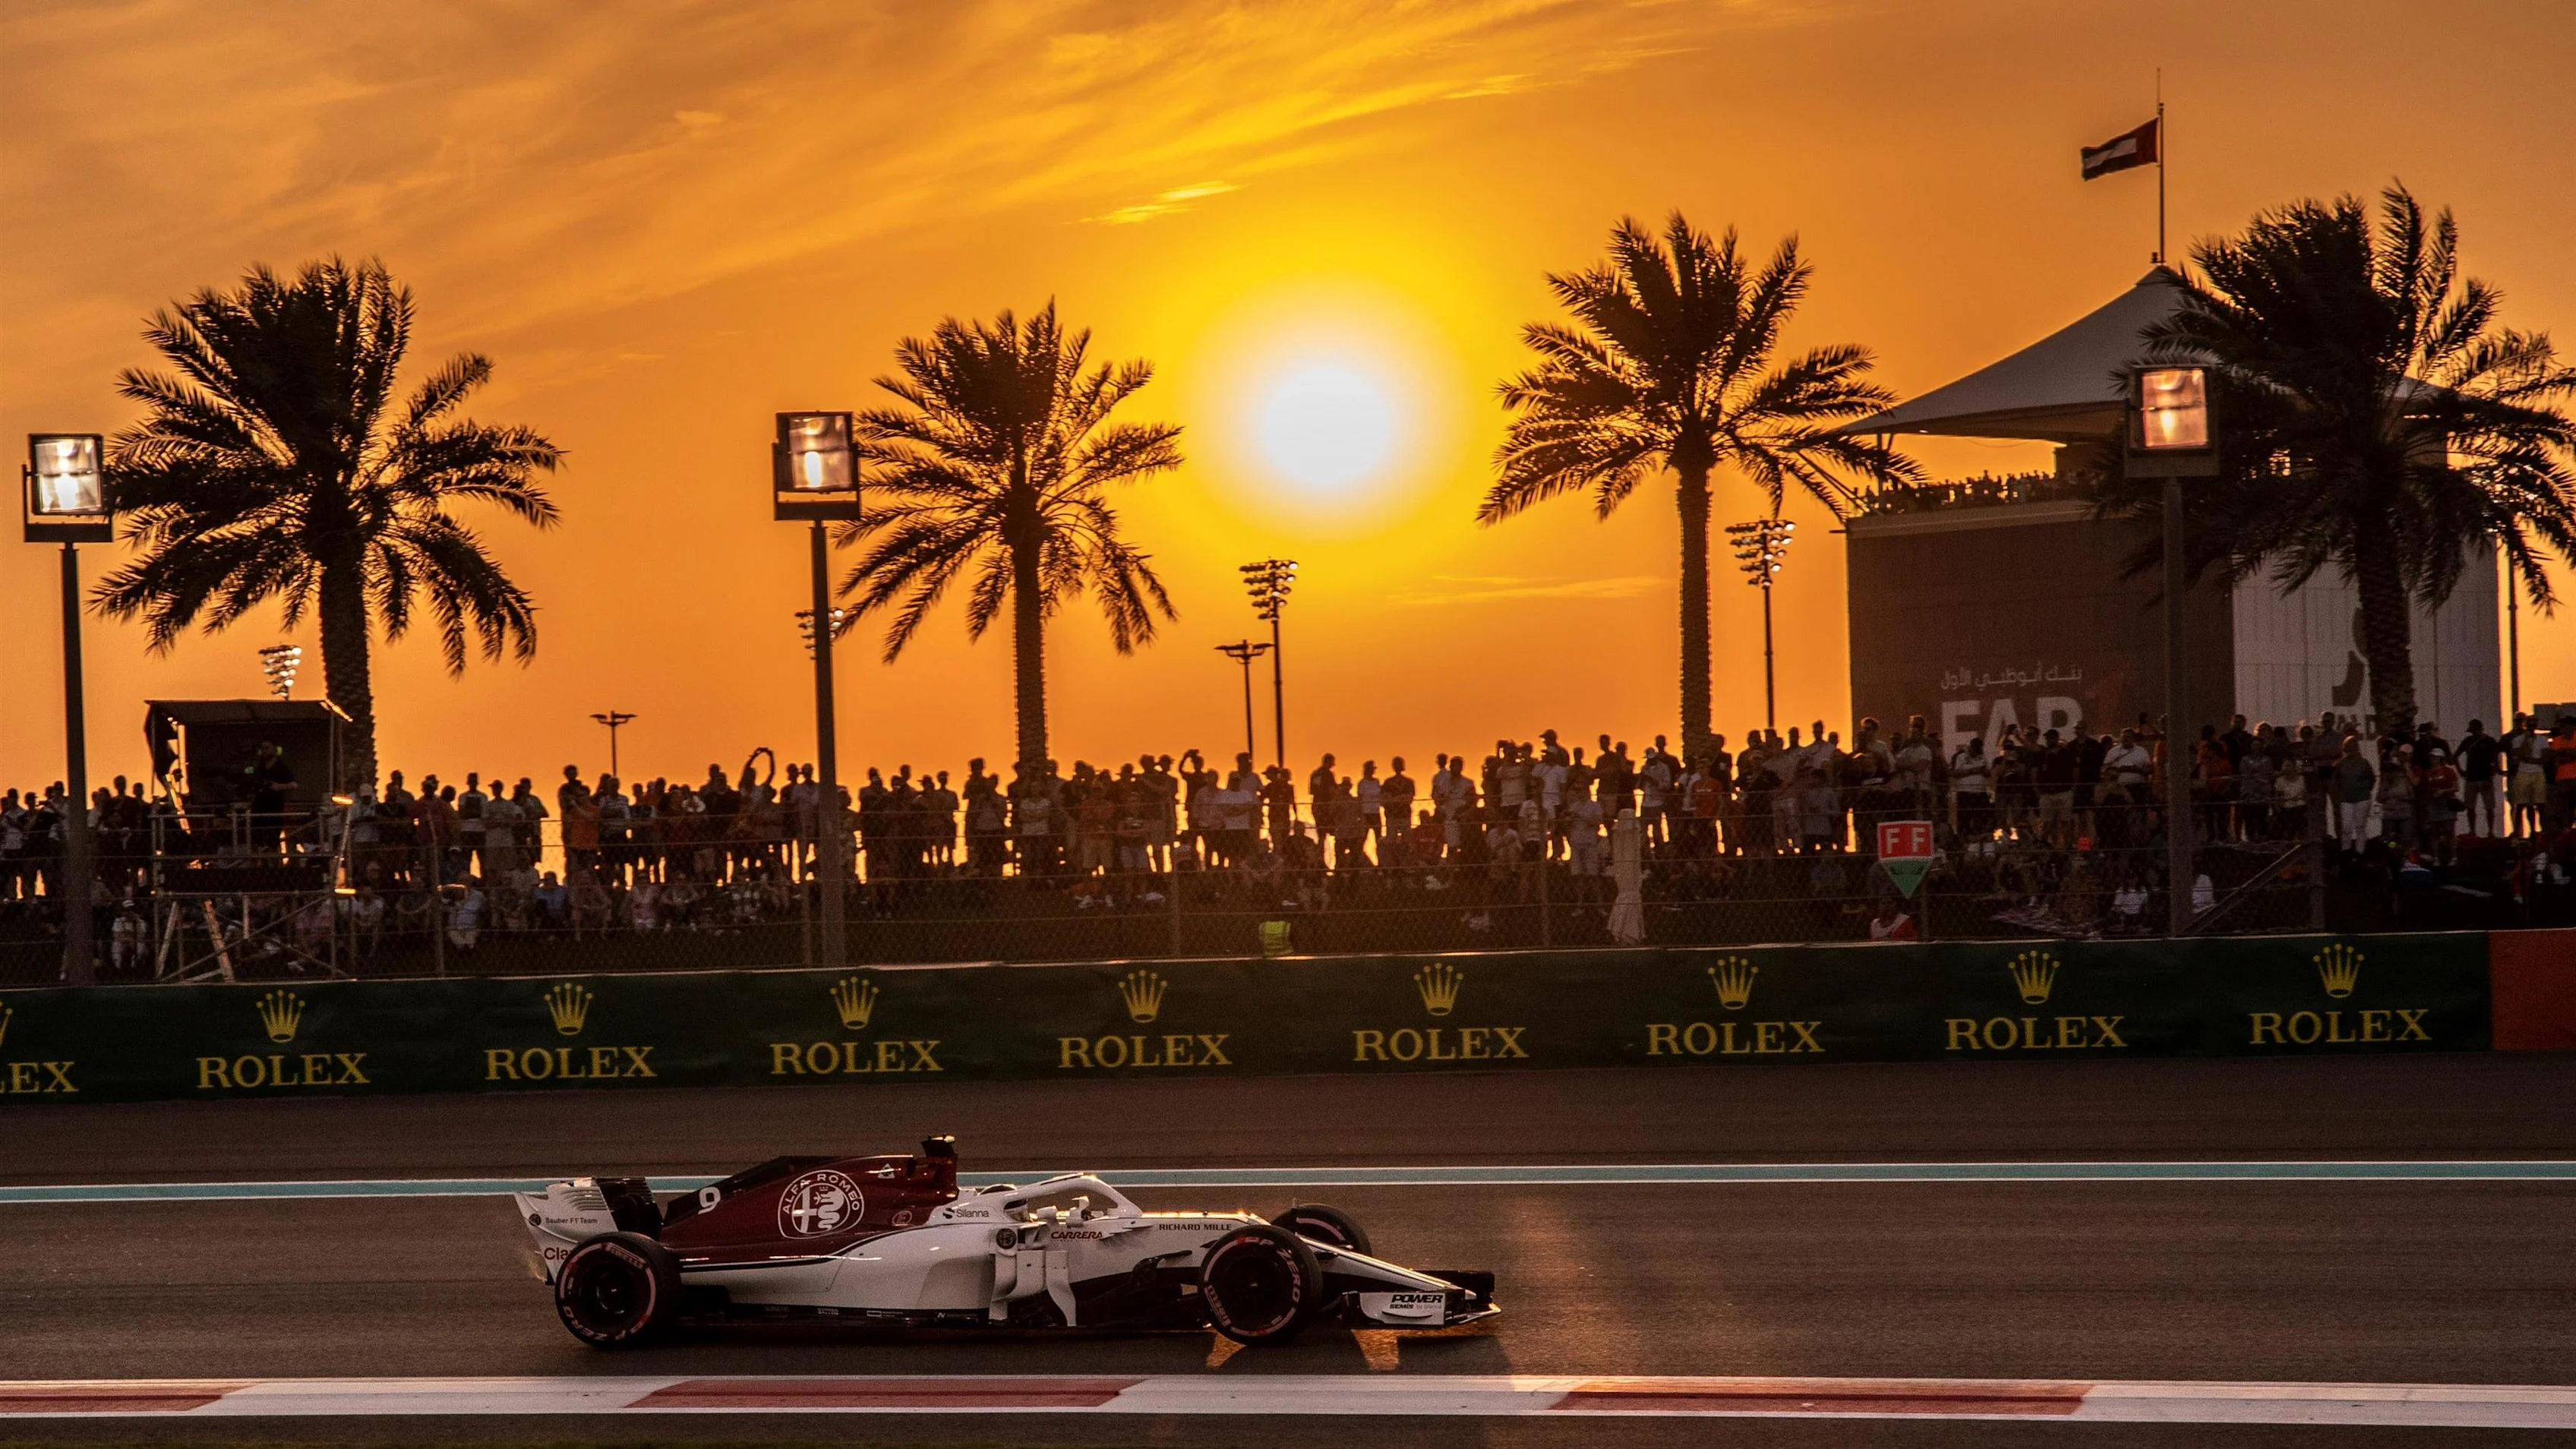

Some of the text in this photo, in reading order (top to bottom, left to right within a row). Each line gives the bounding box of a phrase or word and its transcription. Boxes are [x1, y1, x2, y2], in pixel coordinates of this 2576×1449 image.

[1353, 1026, 1526, 1062] ROLEX
[1647, 1021, 1822, 1056] ROLEX
[1947, 1015, 2125, 1050] ROLEX
[2251, 1009, 2428, 1044] ROLEX
[486, 1046, 655, 1081] ROLEX
[771, 1039, 942, 1074] ROLEX
[1059, 1033, 1230, 1068] ROLEX
[0, 1061, 79, 1094] EX
[198, 1053, 370, 1088] ROLEX
[697, 1186, 721, 1215] 9
[782, 1173, 860, 1214] ALFA ROMEO
[956, 1209, 989, 1218] Silanna
[1050, 1231, 1103, 1239] CARRERA
[1391, 1294, 1444, 1303] POWER
